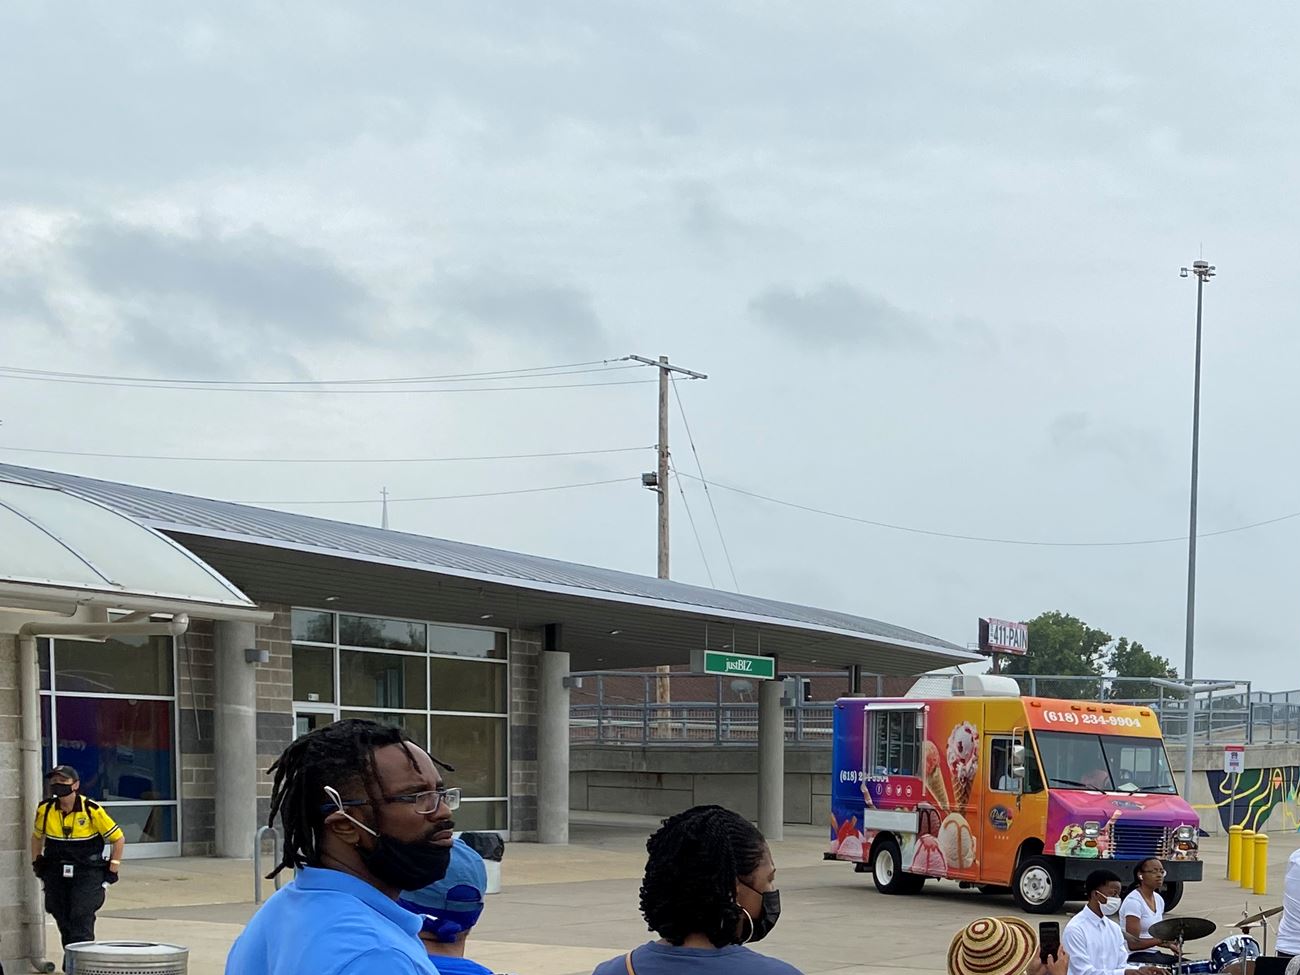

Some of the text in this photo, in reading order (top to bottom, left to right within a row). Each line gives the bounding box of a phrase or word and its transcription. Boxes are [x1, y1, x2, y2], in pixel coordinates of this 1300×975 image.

[725, 658, 752, 672] justBIZ
[1043, 710, 1141, 728] (618) 234-9904
[839, 770, 857, 783] (618)
